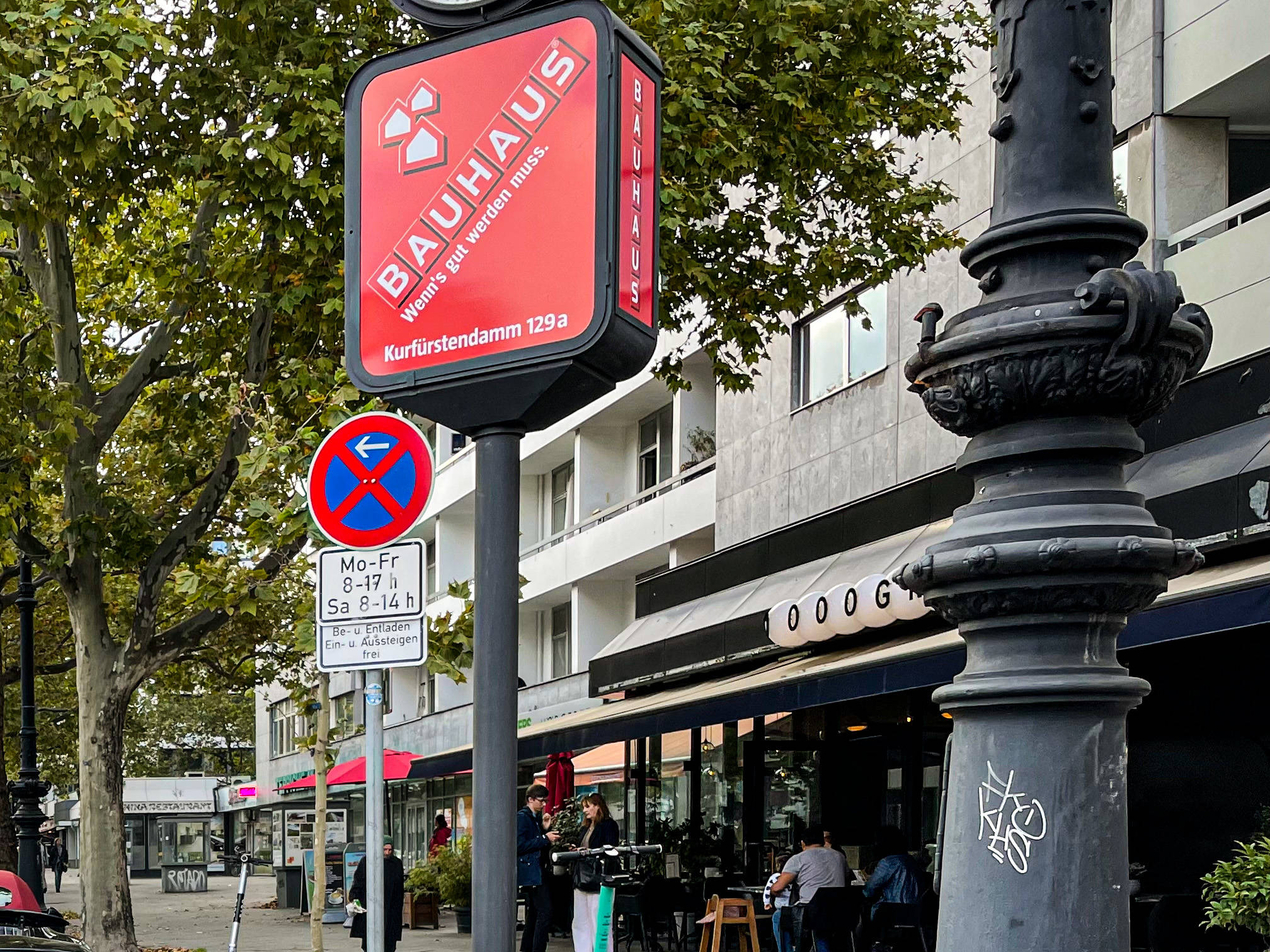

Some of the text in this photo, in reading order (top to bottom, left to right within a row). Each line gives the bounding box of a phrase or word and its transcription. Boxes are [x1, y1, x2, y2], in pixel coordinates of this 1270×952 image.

[376, 49, 576, 299] BAUHAUS
[631, 78, 642, 304] BAUHAUS
[399, 145, 549, 323] Wenn's gut werden muss.
[383, 321, 522, 363] Kurfürstendamm
[340, 552, 400, 573] Mo-Fr
[343, 572, 398, 594] 8-17 h
[327, 591, 414, 615] Sa 8-14 h
[332, 626, 351, 637] Be-
[365, 622, 411, 634] Entladen
[325, 640, 346, 650] Ein-
[360, 635, 418, 648] Aussteigen
[362, 650, 380, 659] frei
